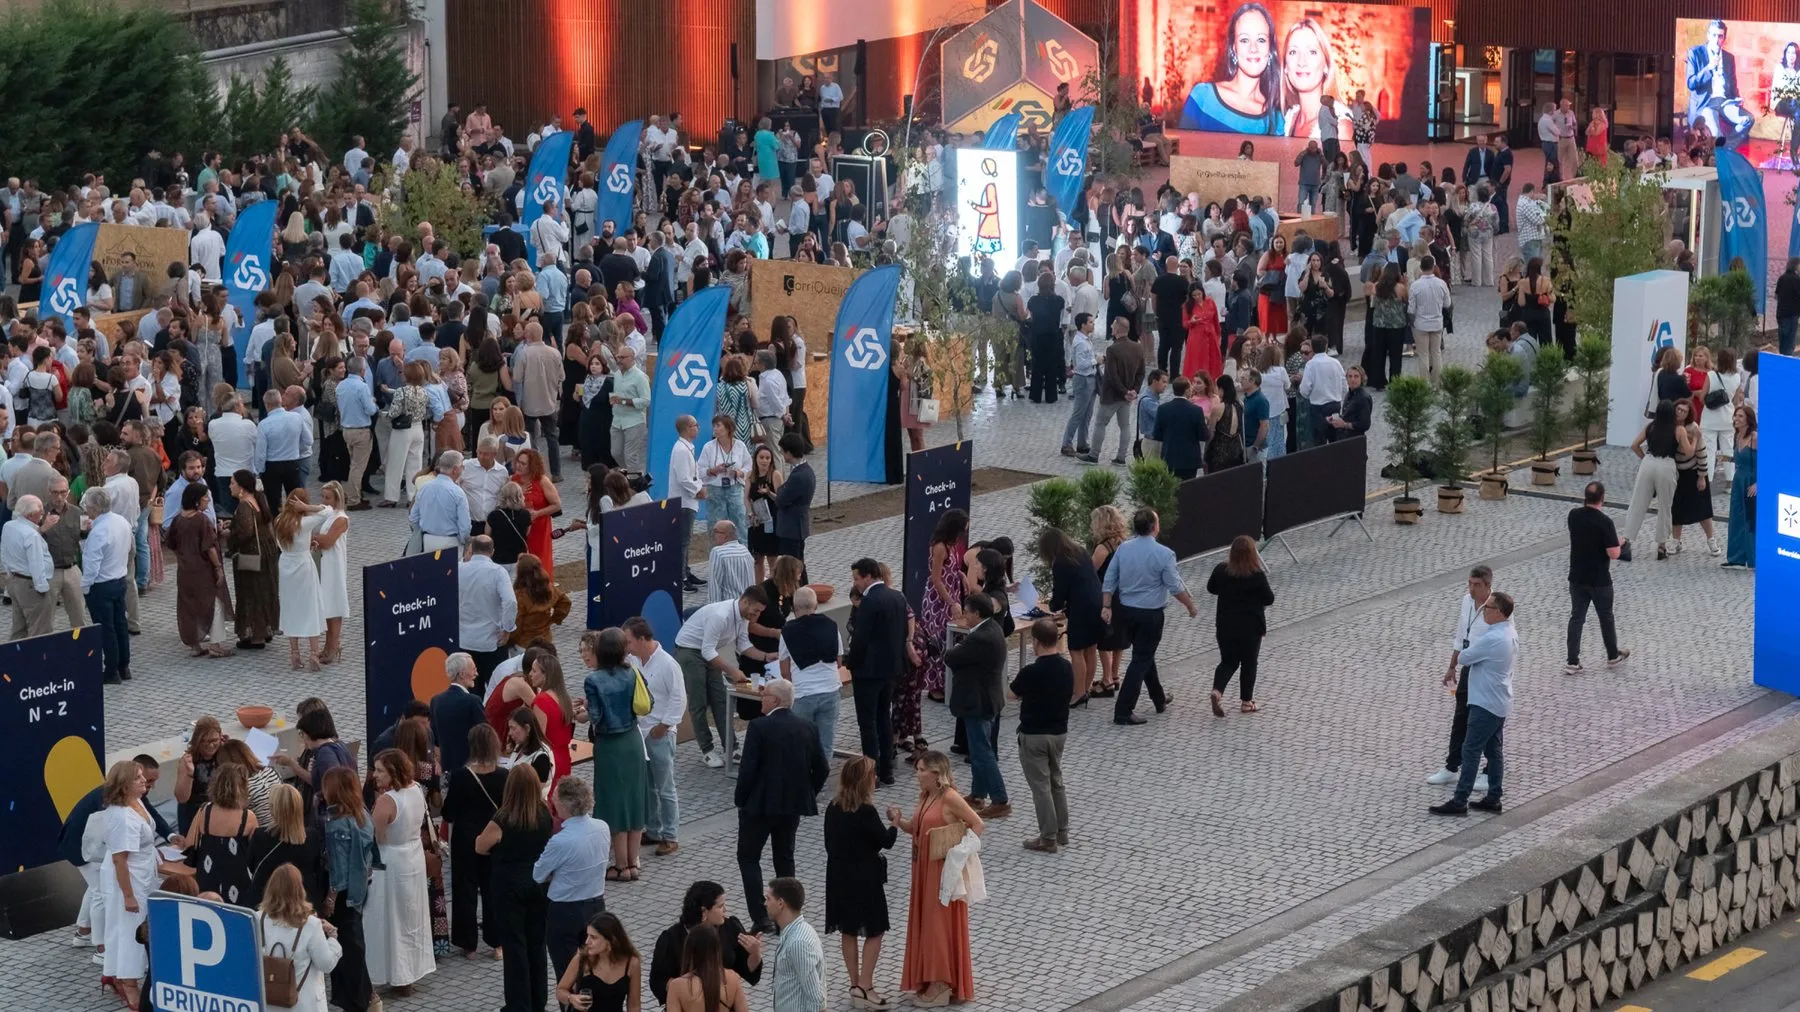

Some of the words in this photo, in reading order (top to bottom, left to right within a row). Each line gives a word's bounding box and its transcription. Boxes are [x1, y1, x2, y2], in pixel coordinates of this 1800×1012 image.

[925, 480, 956, 495] Check-in
[929, 500, 936, 512] A
[944, 497, 951, 508] C
[624, 541, 663, 559] Check-in
[632, 564, 640, 578] D
[651, 560, 656, 573] J
[392, 595, 437, 615] Check-in
[398, 622, 406, 635] L
[419, 615, 431, 631] M
[20, 678, 75, 700] Check-in
[29, 706, 41, 723] N
[58, 701, 67, 716] Z
[178, 902, 226, 988] P
